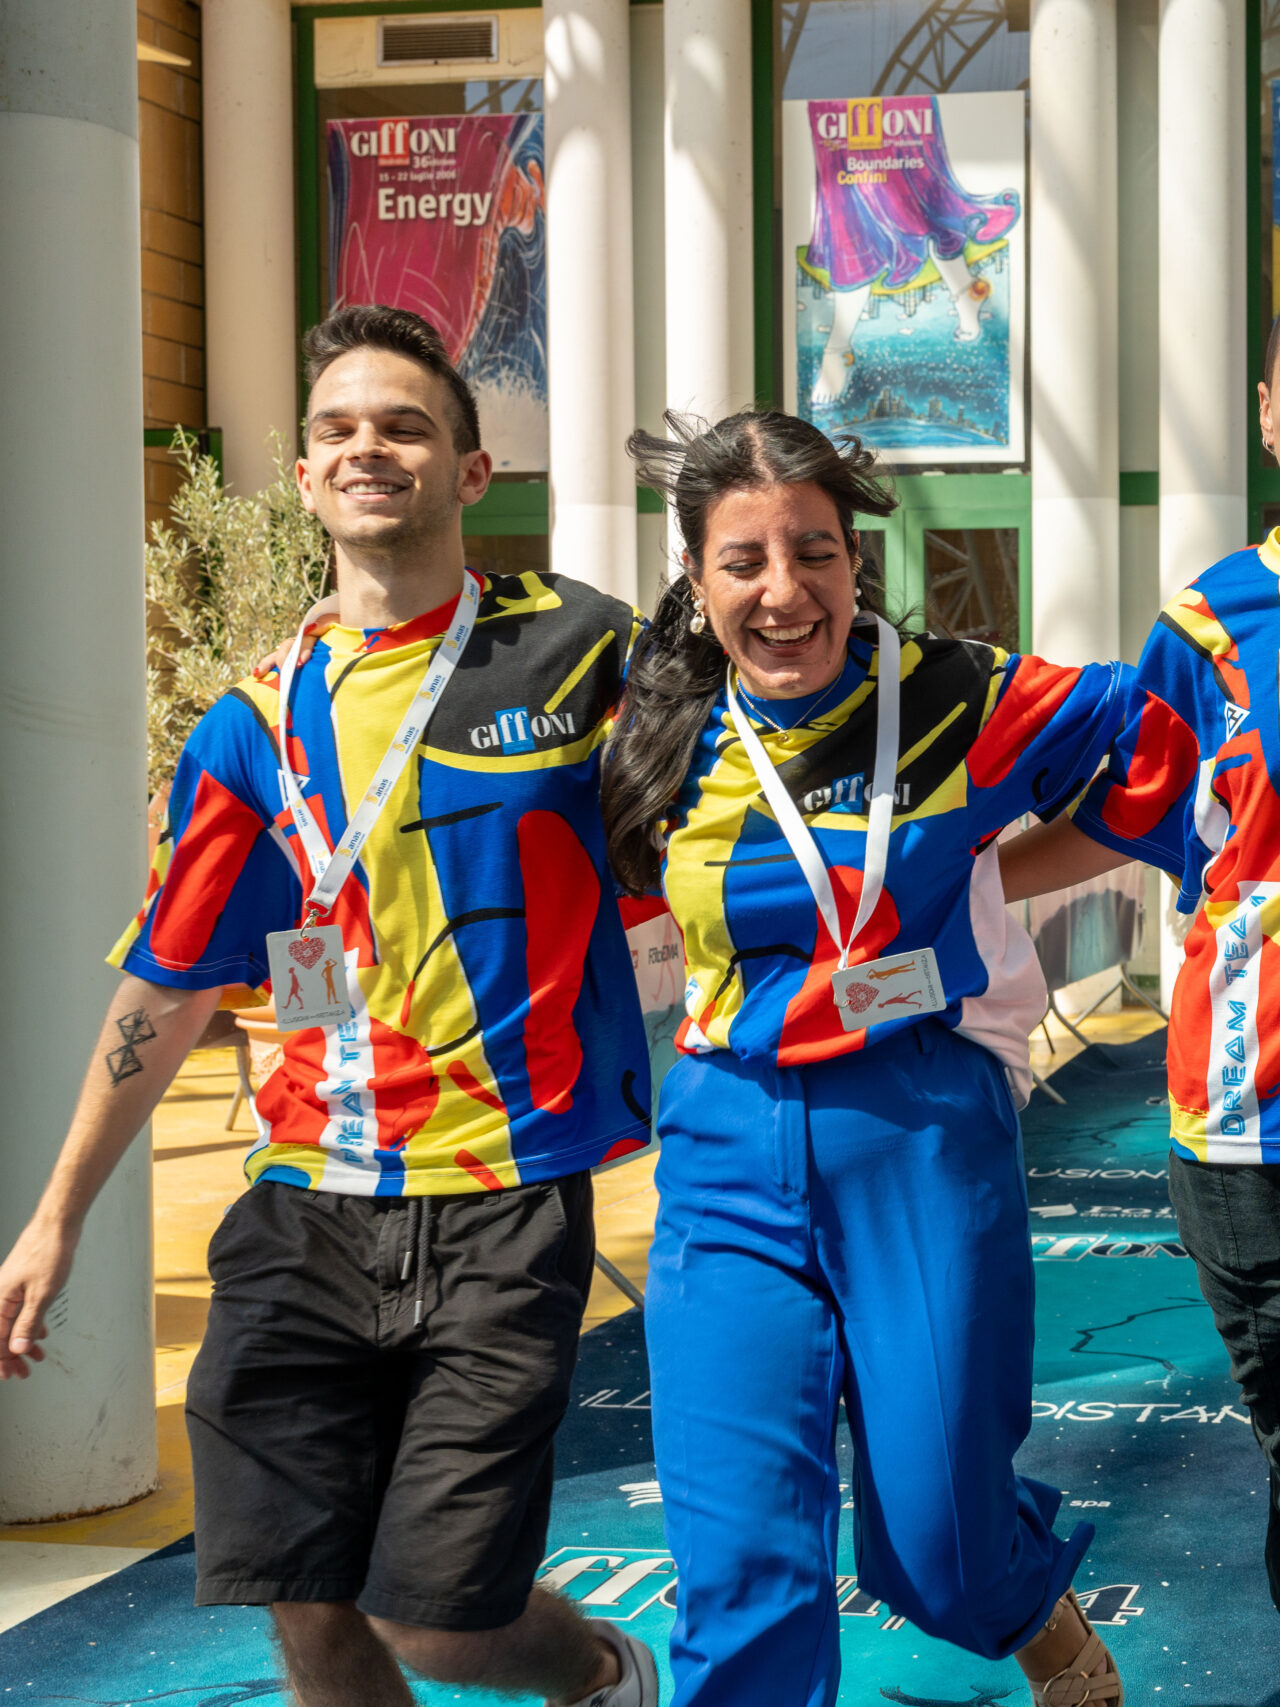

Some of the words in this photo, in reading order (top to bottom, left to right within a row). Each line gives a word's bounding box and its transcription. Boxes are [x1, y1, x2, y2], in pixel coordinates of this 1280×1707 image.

[847, 156, 924, 172] Boundaries
[837, 170, 887, 185] Confini
[378, 188, 492, 226] Energy
[1220, 1000, 1247, 1136] DREAM
[1069, 1499, 1112, 1508] spa
